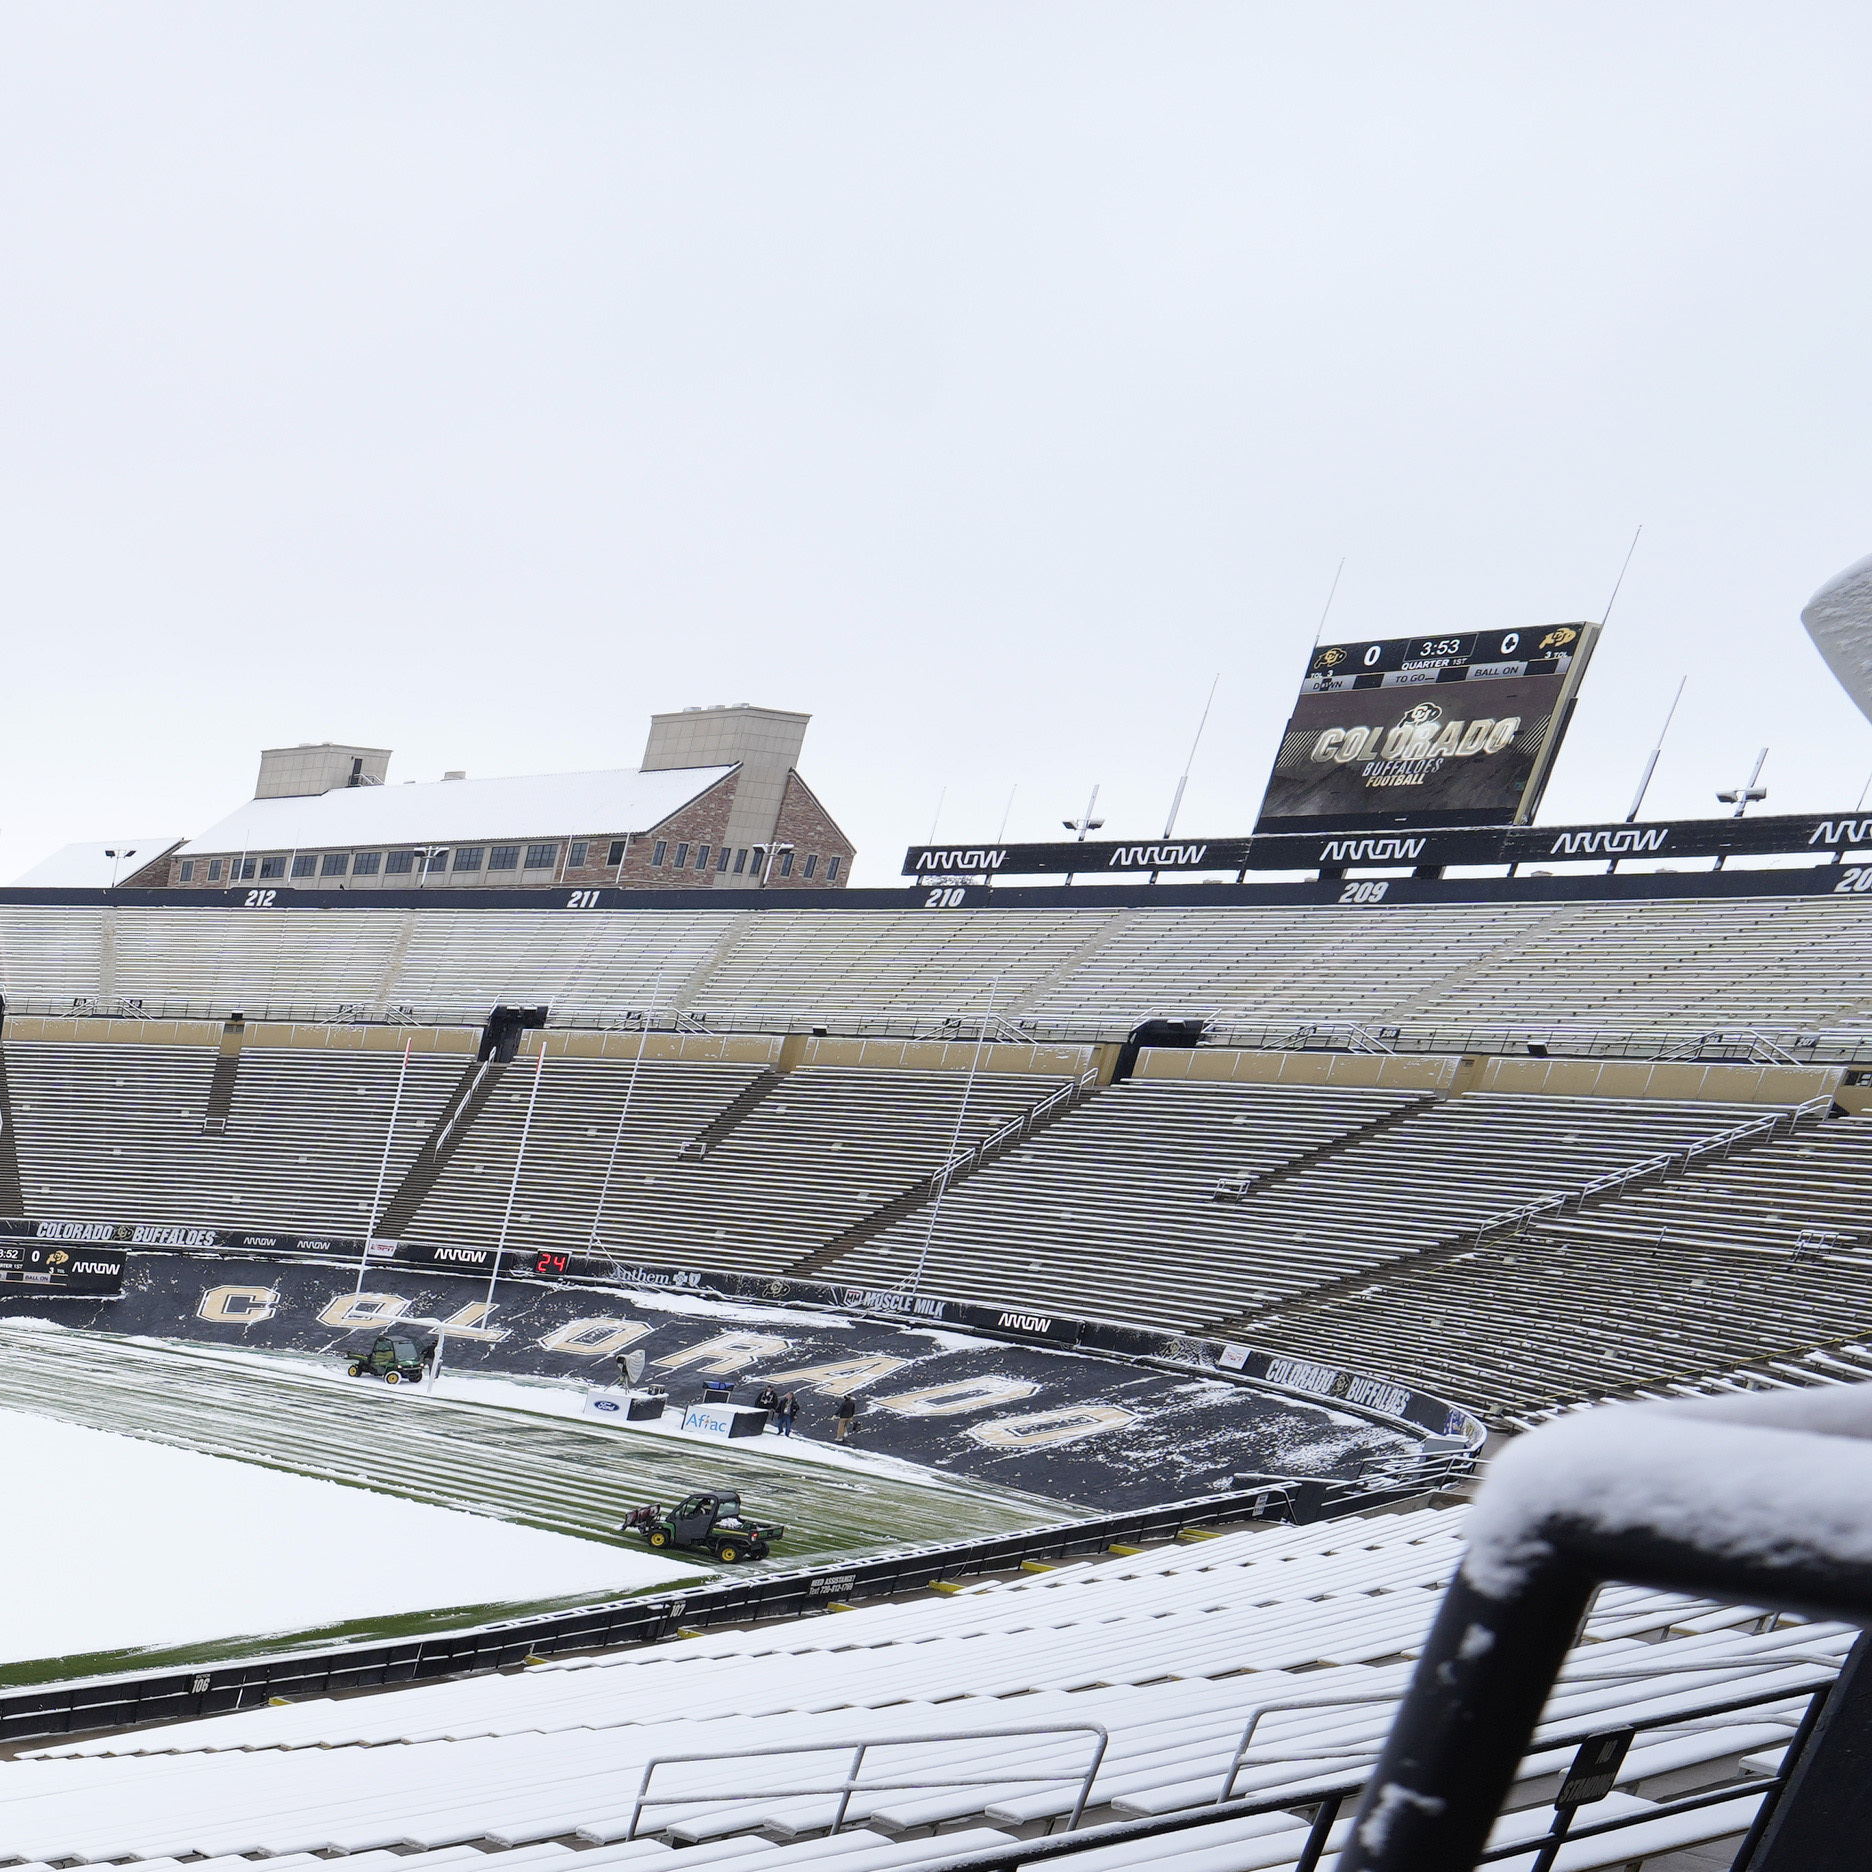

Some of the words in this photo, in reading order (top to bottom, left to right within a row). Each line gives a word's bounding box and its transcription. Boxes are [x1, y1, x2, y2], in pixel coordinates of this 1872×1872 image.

[1420, 639, 1461, 657] 3:53
[1500, 633, 1520, 655] 0
[1363, 645, 1382, 666] 0
[1401, 658, 1450, 671] QUARTER
[1452, 657, 1468, 666] 1ST
[1544, 651, 1552, 659] 3
[1326, 669, 1334, 678] 3
[1395, 674, 1408, 683] TO
[1409, 673, 1426, 683] GO
[1474, 667, 1501, 677] BALL
[1502, 665, 1519, 675] ON
[1310, 716, 1522, 763] COLORADO
[1362, 757, 1445, 778] BUFFALOES
[1365, 773, 1425, 788] FOOTBALL
[1319, 837, 1427, 862] ARROW
[1550, 828, 1669, 854] ARROW
[916, 850, 1007, 870] ARROW
[1108, 845, 1207, 866] ARROW
[244, 889, 277, 907] 212
[566, 890, 601, 909] 211
[924, 888, 966, 908] 210
[1338, 881, 1390, 903] 209
[36, 1222, 113, 1240] COLORADO
[131, 1226, 216, 1246] BUFFALOES
[243, 1236, 277, 1247] ARROW
[296, 1239, 331, 1250] ARROW
[370, 1243, 394, 1253] ESPN
[31, 1250, 41, 1263] 0
[434, 1247, 487, 1263] ARROW
[537, 1253, 566, 1272] 24
[48, 1266, 55, 1274] 3
[71, 1261, 121, 1275] ARROW
[610, 1267, 670, 1285] Anthem
[863, 1291, 913, 1312] MUSCLE
[915, 1299, 947, 1318] MILK
[997, 1312, 1052, 1333] ARROW
[196, 1285, 1143, 1447] COLORADO
[1265, 1358, 1337, 1394] COLORADO
[1345, 1375, 1412, 1417] BUFFALOES
[597, 1401, 618, 1411] Ford
[685, 1413, 727, 1432] Aflac
[669, 1603, 687, 1618] 107
[191, 1677, 211, 1694] 106
[1594, 1738, 1618, 1765] NO
[1559, 1771, 1616, 1803] STANDING
